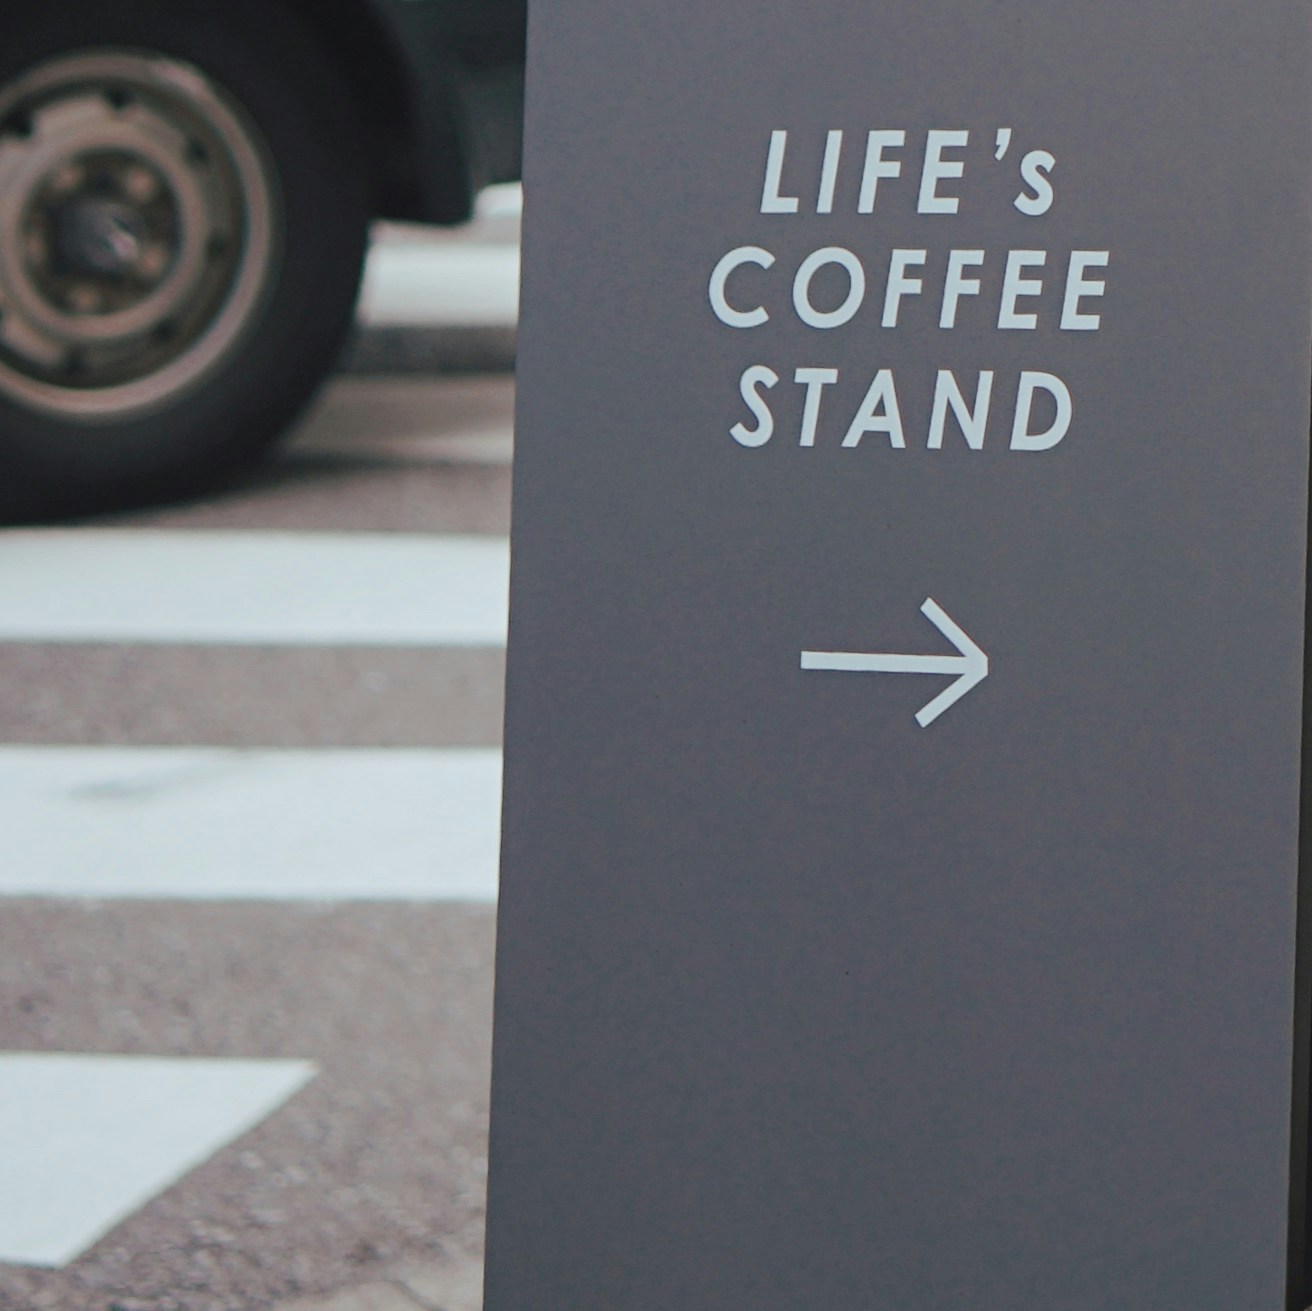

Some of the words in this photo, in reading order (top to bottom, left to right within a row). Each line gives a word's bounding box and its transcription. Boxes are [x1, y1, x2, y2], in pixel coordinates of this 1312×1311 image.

[760, 128, 1057, 216] LIFE's
[708, 246, 1110, 330] COFFEE
[730, 365, 1073, 451] STAND
